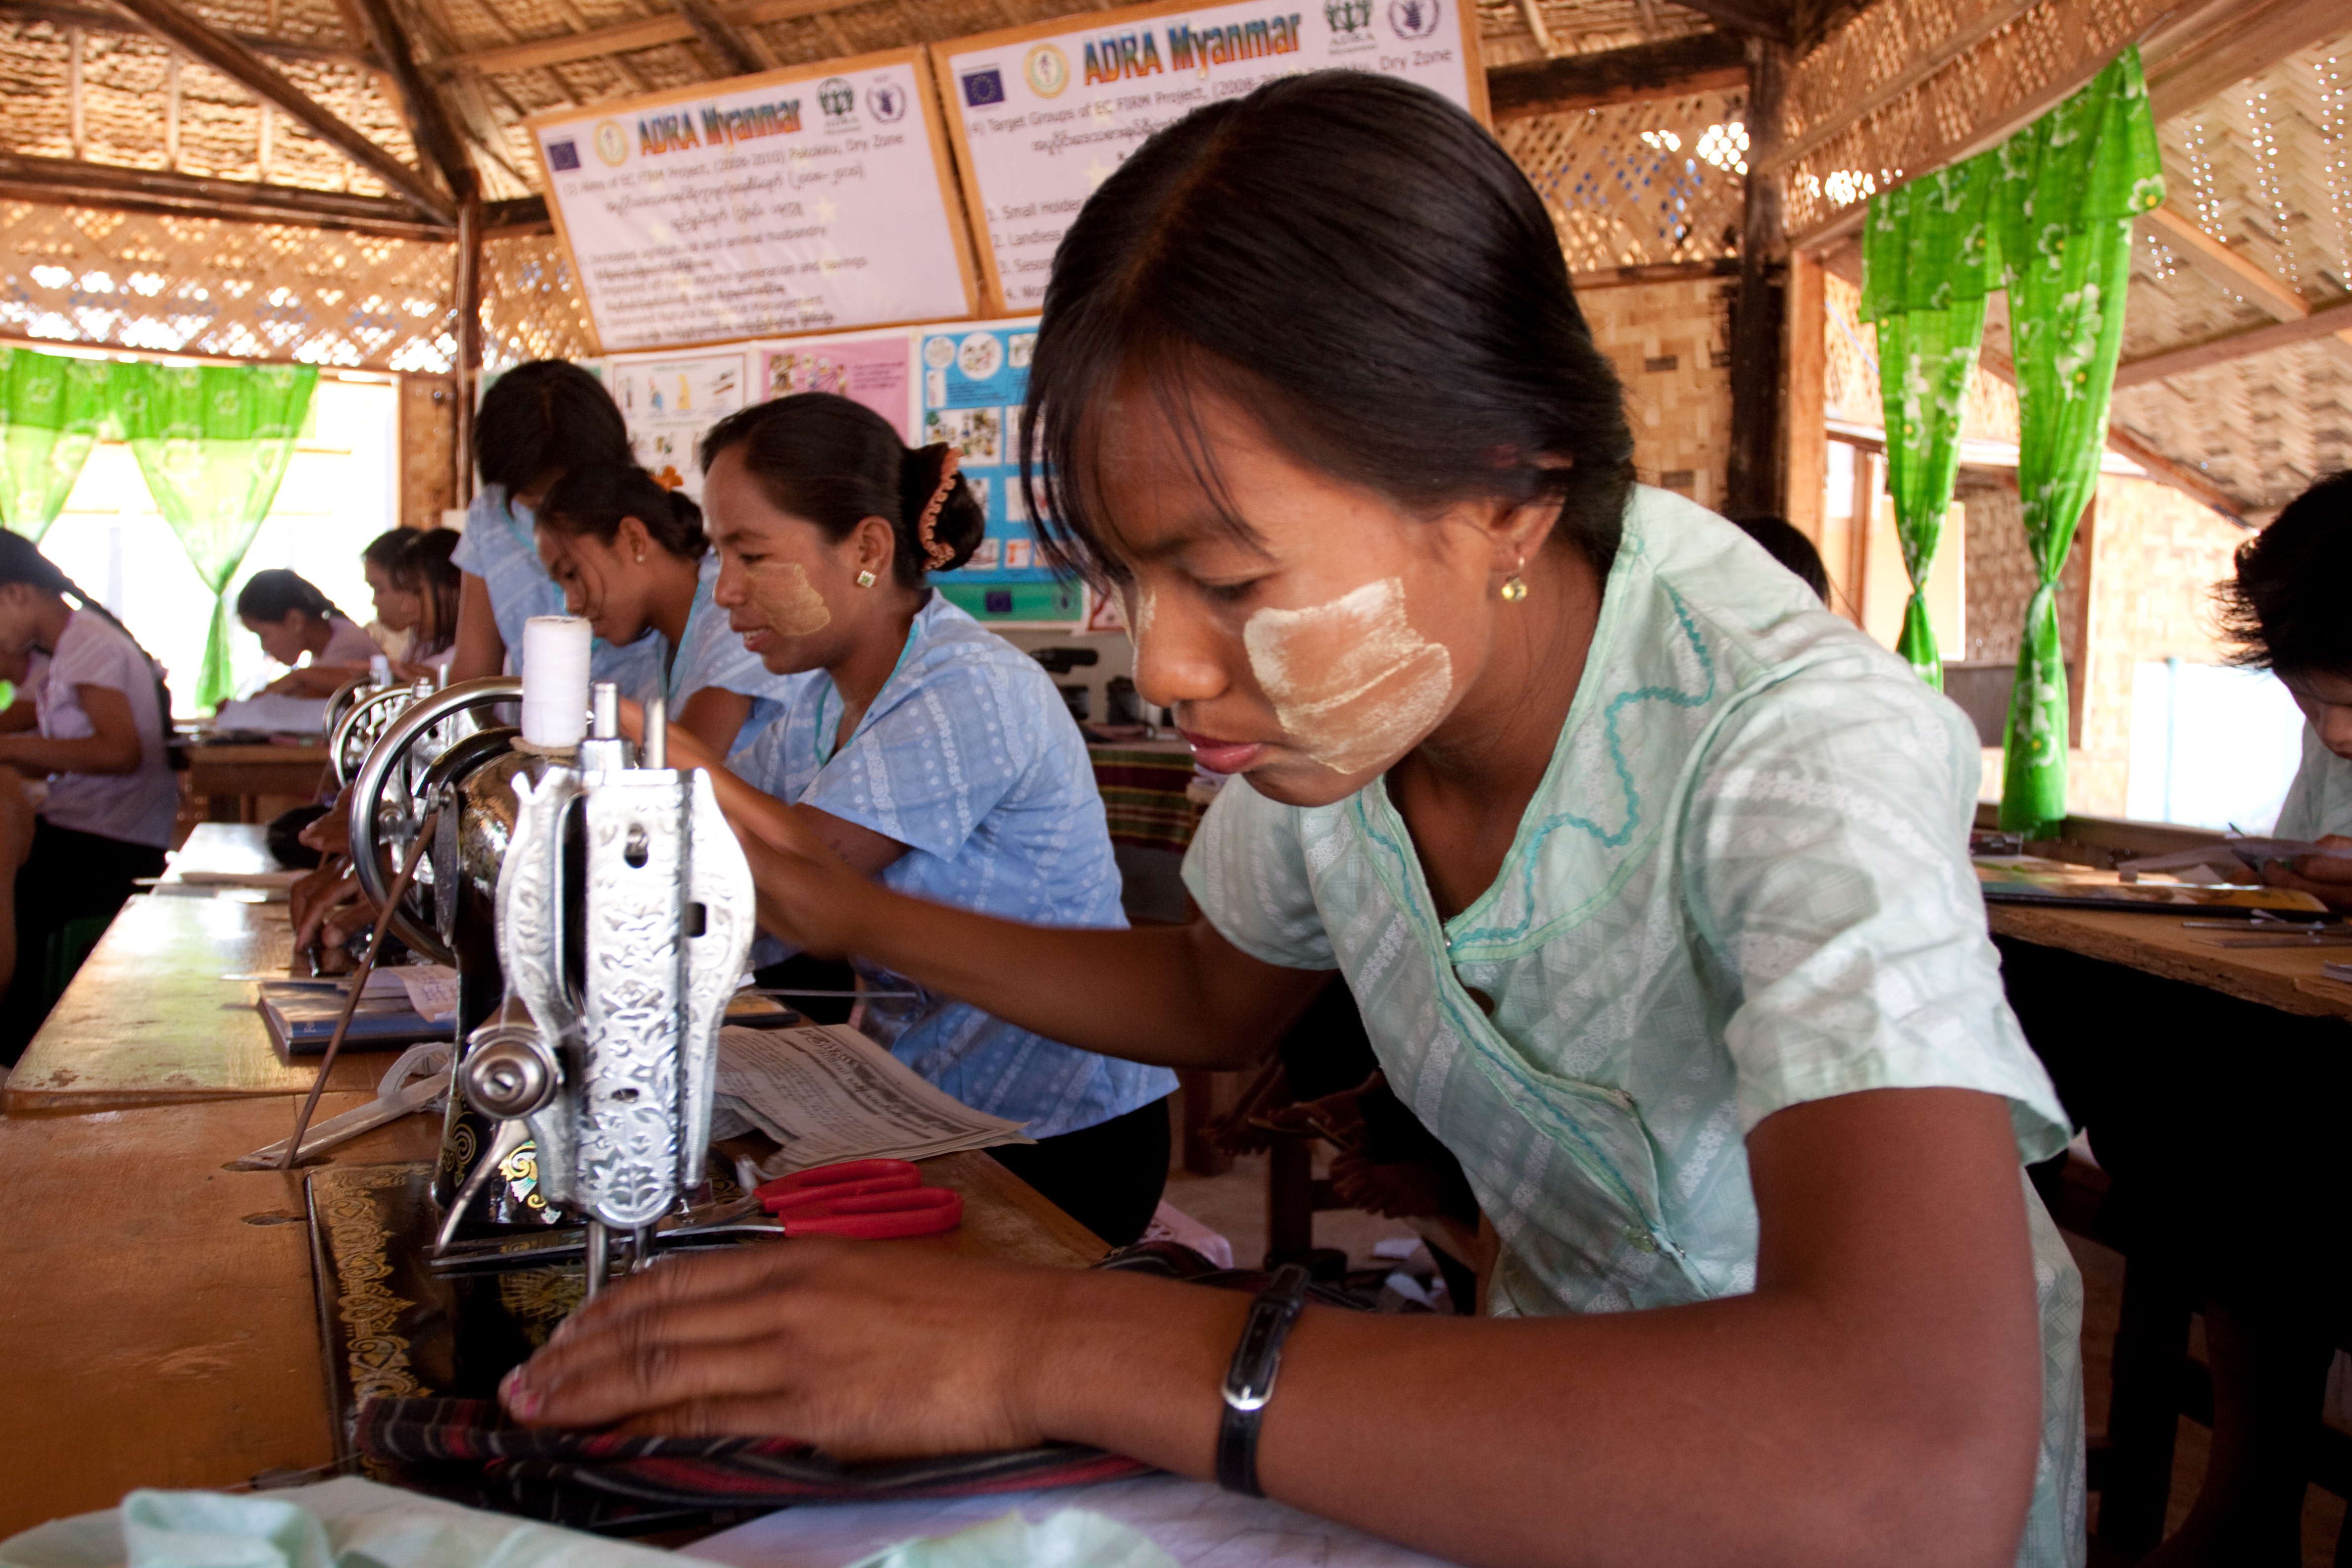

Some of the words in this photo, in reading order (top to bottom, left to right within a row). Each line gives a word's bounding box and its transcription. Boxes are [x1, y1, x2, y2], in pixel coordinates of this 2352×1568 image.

[1084, 27, 1163, 86] ADRA
[1165, 12, 1301, 80] Myanmar
[987, 116, 1026, 132] Target
[1028, 109, 1074, 125] Groups
[1078, 102, 1091, 117] of
[1094, 99, 1113, 114] EC
[1117, 93, 1151, 110] FIRM
[1379, 55, 1407, 71] Dry
[1413, 49, 1451, 66] Zone
[639, 110, 700, 156] ADRA
[701, 98, 801, 152] Myanmar
[845, 138, 868, 152] Dry
[873, 134, 904, 147] Zone
[1002, 202, 1036, 219] Small
